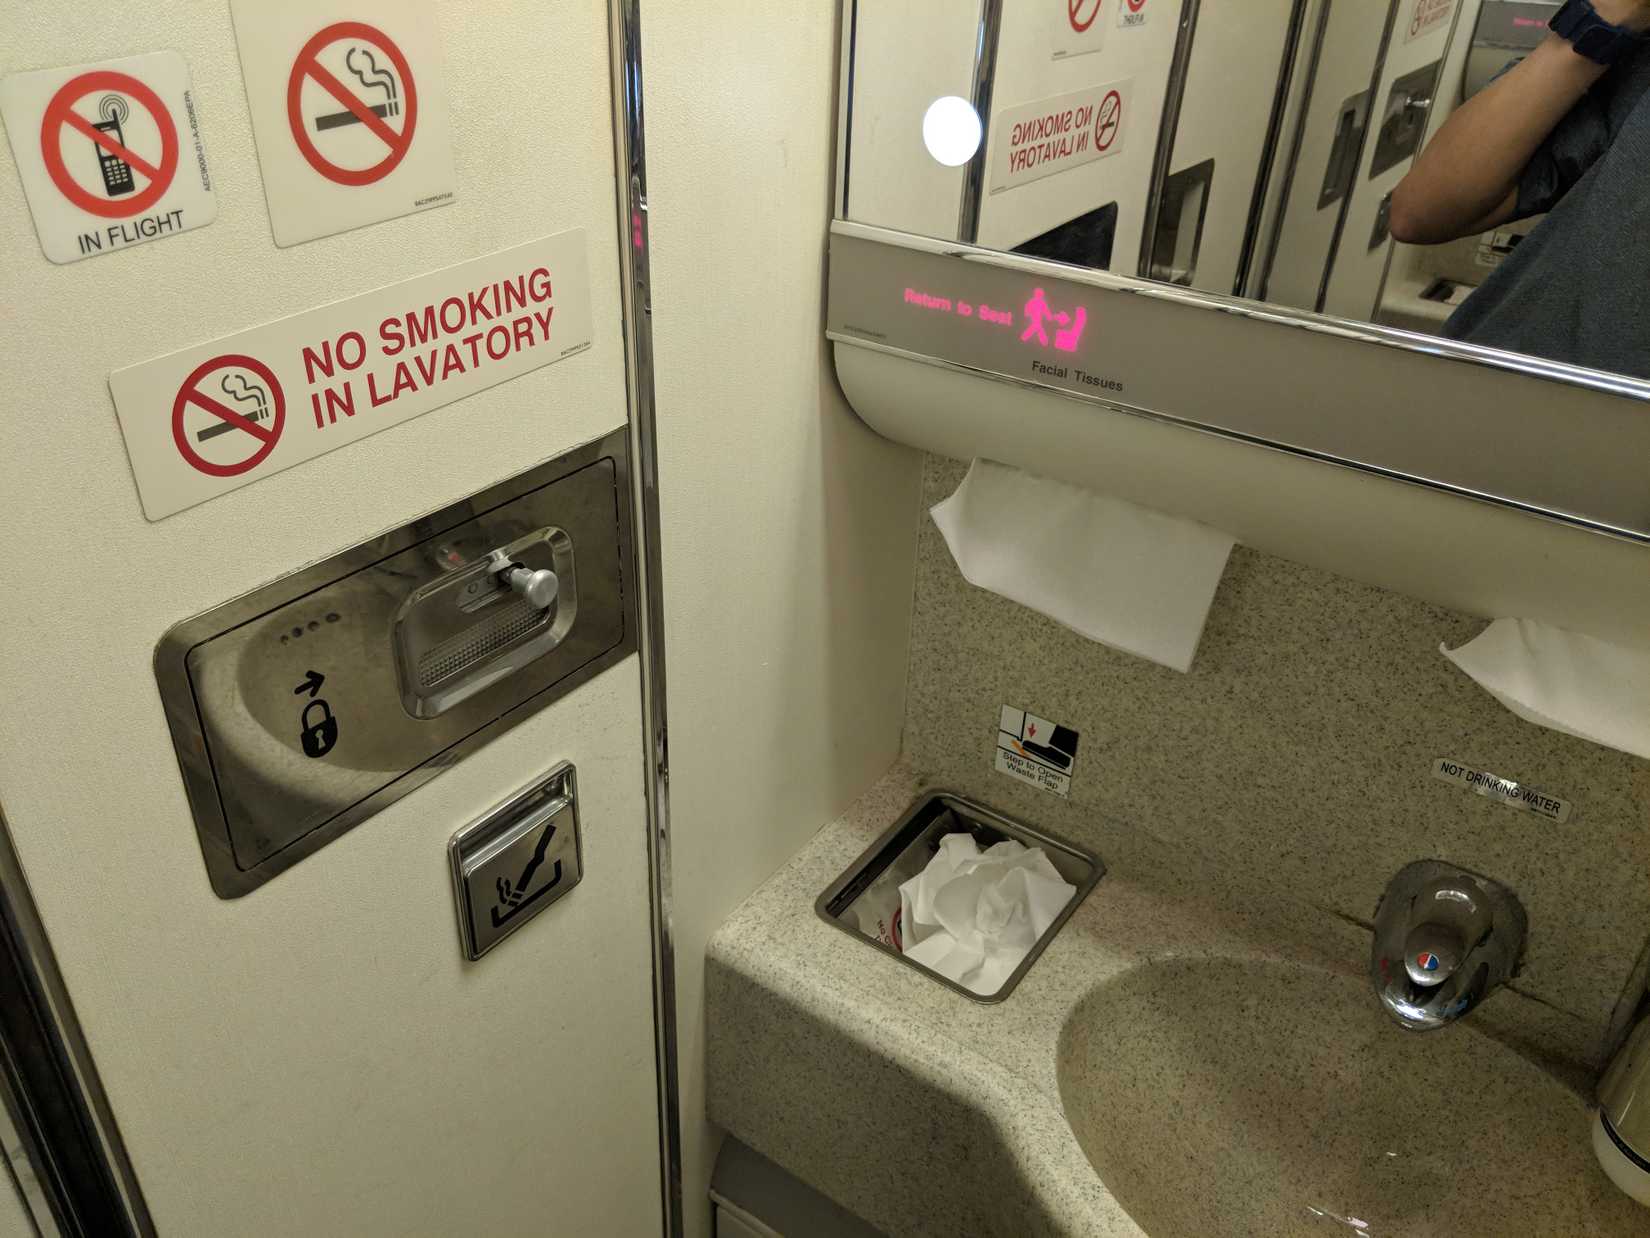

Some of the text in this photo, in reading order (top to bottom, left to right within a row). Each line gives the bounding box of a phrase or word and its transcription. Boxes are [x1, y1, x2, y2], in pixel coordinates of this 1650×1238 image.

[78, 209, 184, 254] IN FLIGHT
[302, 267, 553, 385] NO SMOKING
[903, 288, 1013, 327] Return to Seat
[311, 306, 555, 430] IN LAVATORY
[1031, 360, 1124, 392] Facial Tissues
[1003, 752, 1064, 783] Step to Open
[1006, 761, 1059, 790] Waste Flap
[1440, 761, 1465, 778] NOT
[1465, 770, 1521, 799] DRINKING
[1522, 790, 1561, 815] WATER
